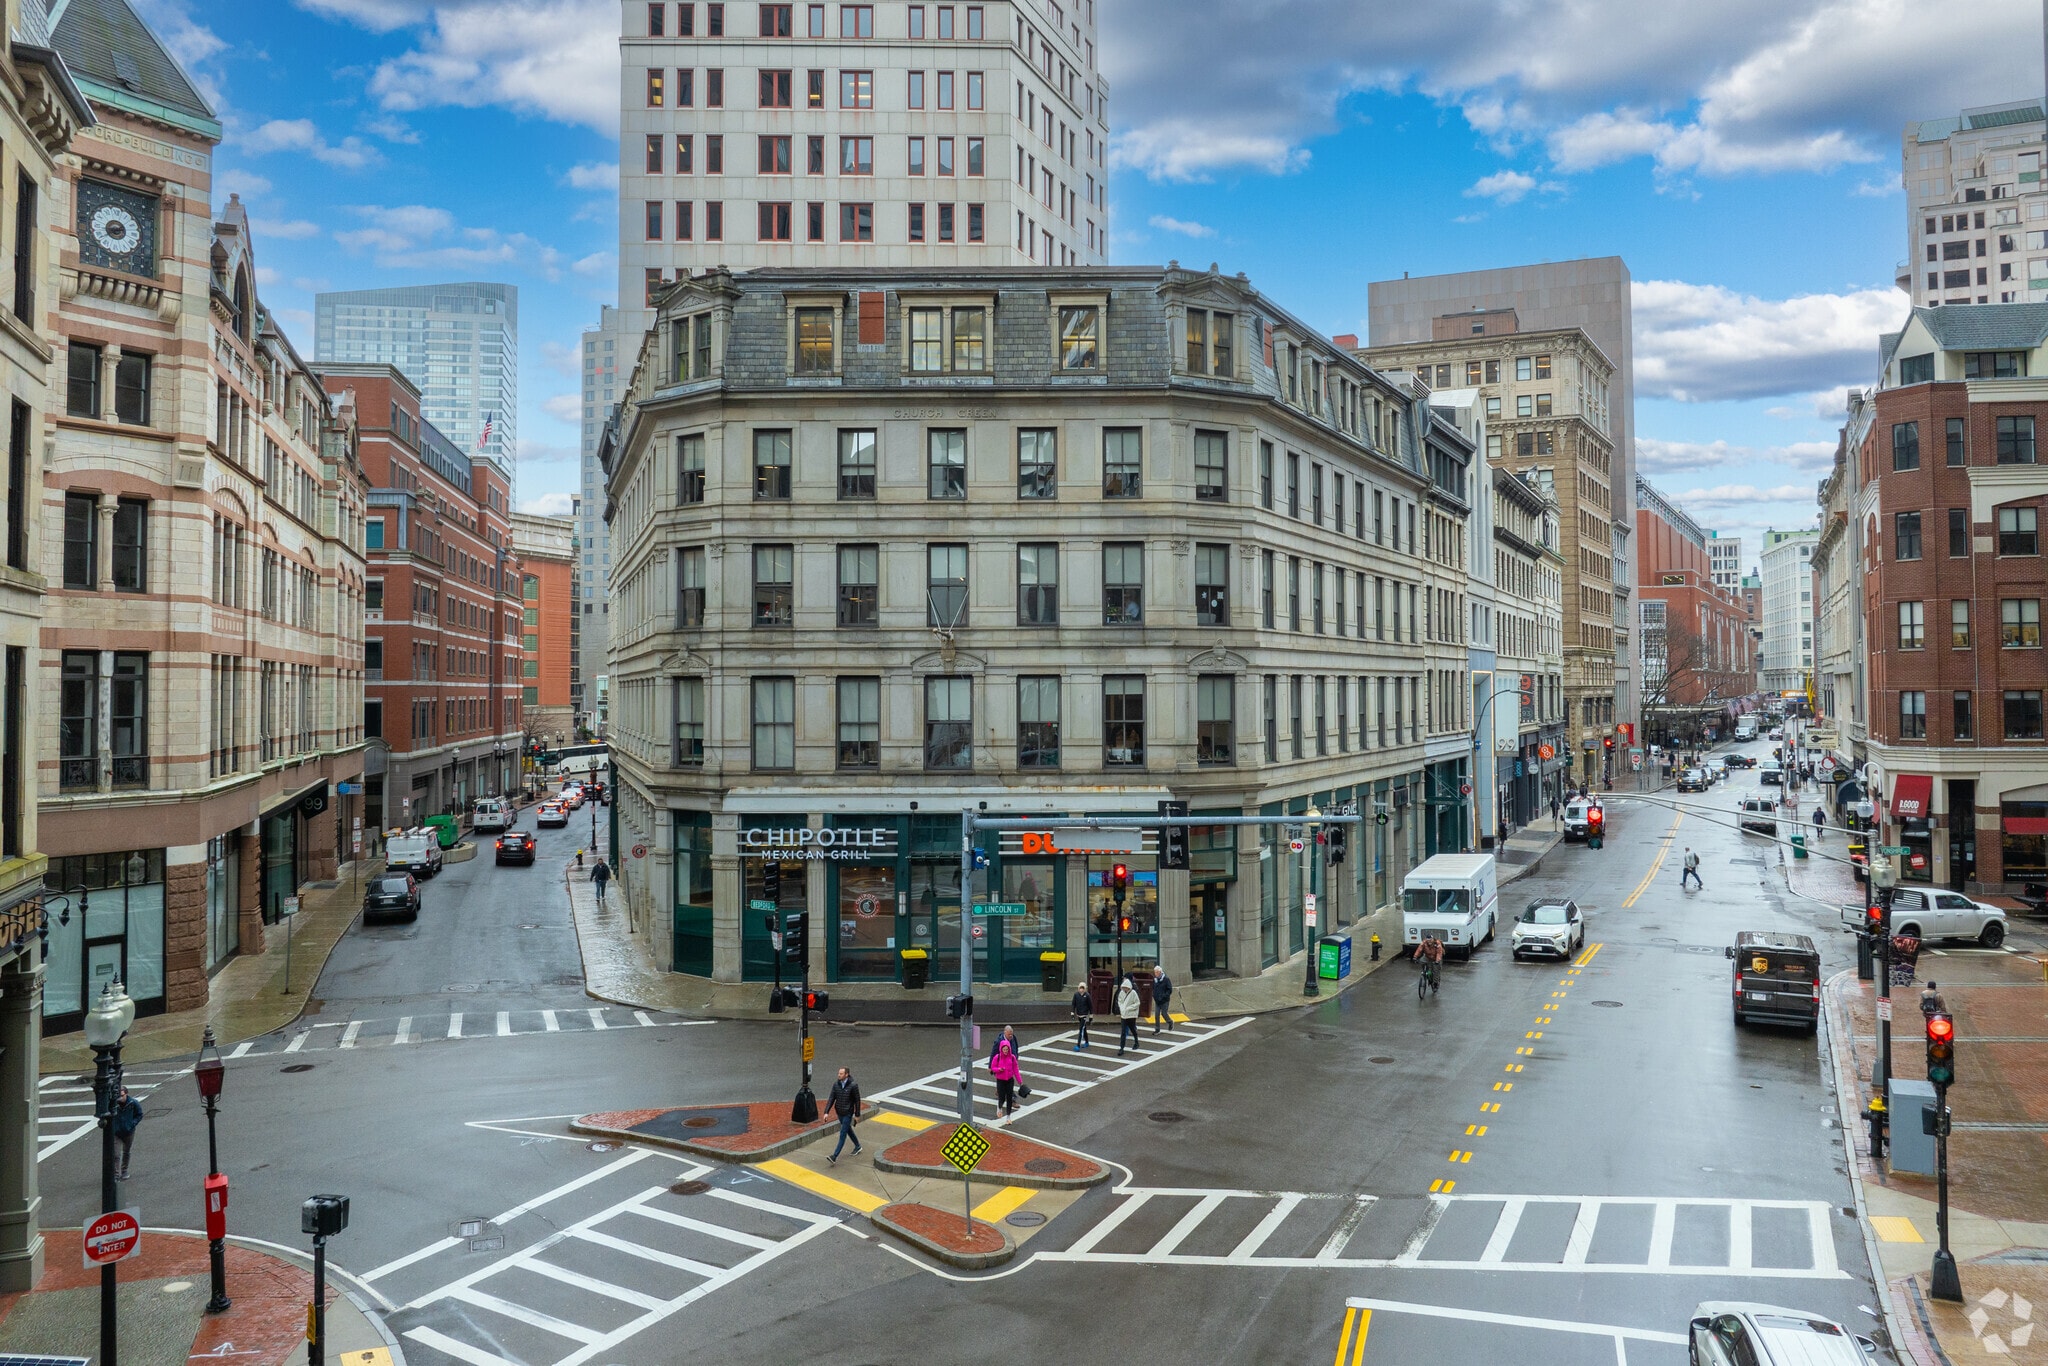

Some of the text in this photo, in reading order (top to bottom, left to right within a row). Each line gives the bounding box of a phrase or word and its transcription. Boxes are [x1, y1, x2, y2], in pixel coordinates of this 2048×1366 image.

[893, 408, 997, 418] CHURCH GREEN
[1498, 738, 1516, 752] 99
[304, 797, 323, 810] 99
[746, 828, 887, 847] CHIPOTLE
[761, 850, 871, 860] MEXICAN GRILL
[984, 905, 1012, 914] LINCOLN
[95, 1219, 128, 1234] DO NOT
[98, 1241, 126, 1255] ENTER
